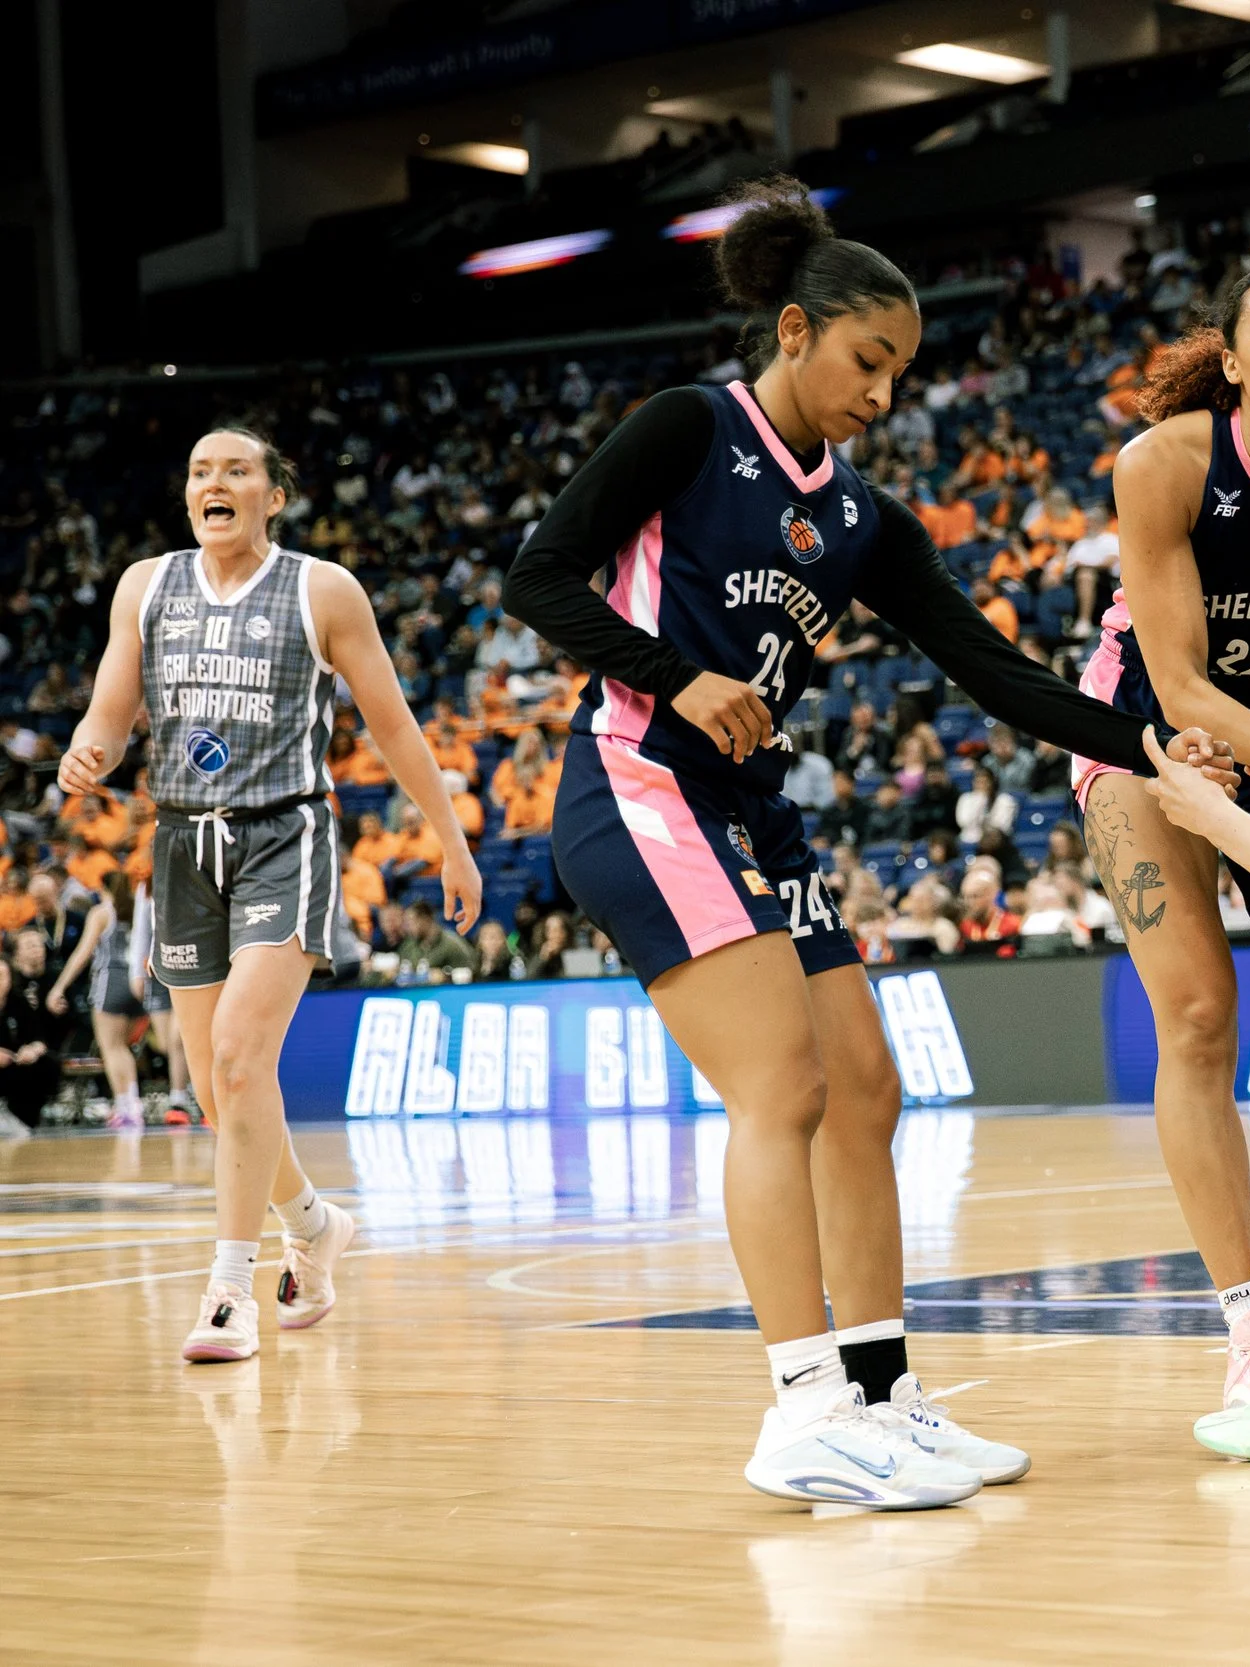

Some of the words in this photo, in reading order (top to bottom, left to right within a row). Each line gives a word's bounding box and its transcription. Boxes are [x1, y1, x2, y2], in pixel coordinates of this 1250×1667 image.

[731, 463, 762, 481] FBT
[1212, 504, 1241, 518] FBT
[165, 602, 196, 617] UWS
[204, 615, 233, 650] 10
[162, 652, 272, 689] CALEDONIA
[749, 631, 795, 702] 24
[244, 903, 282, 915] Reebok
[778, 872, 835, 940] 24
